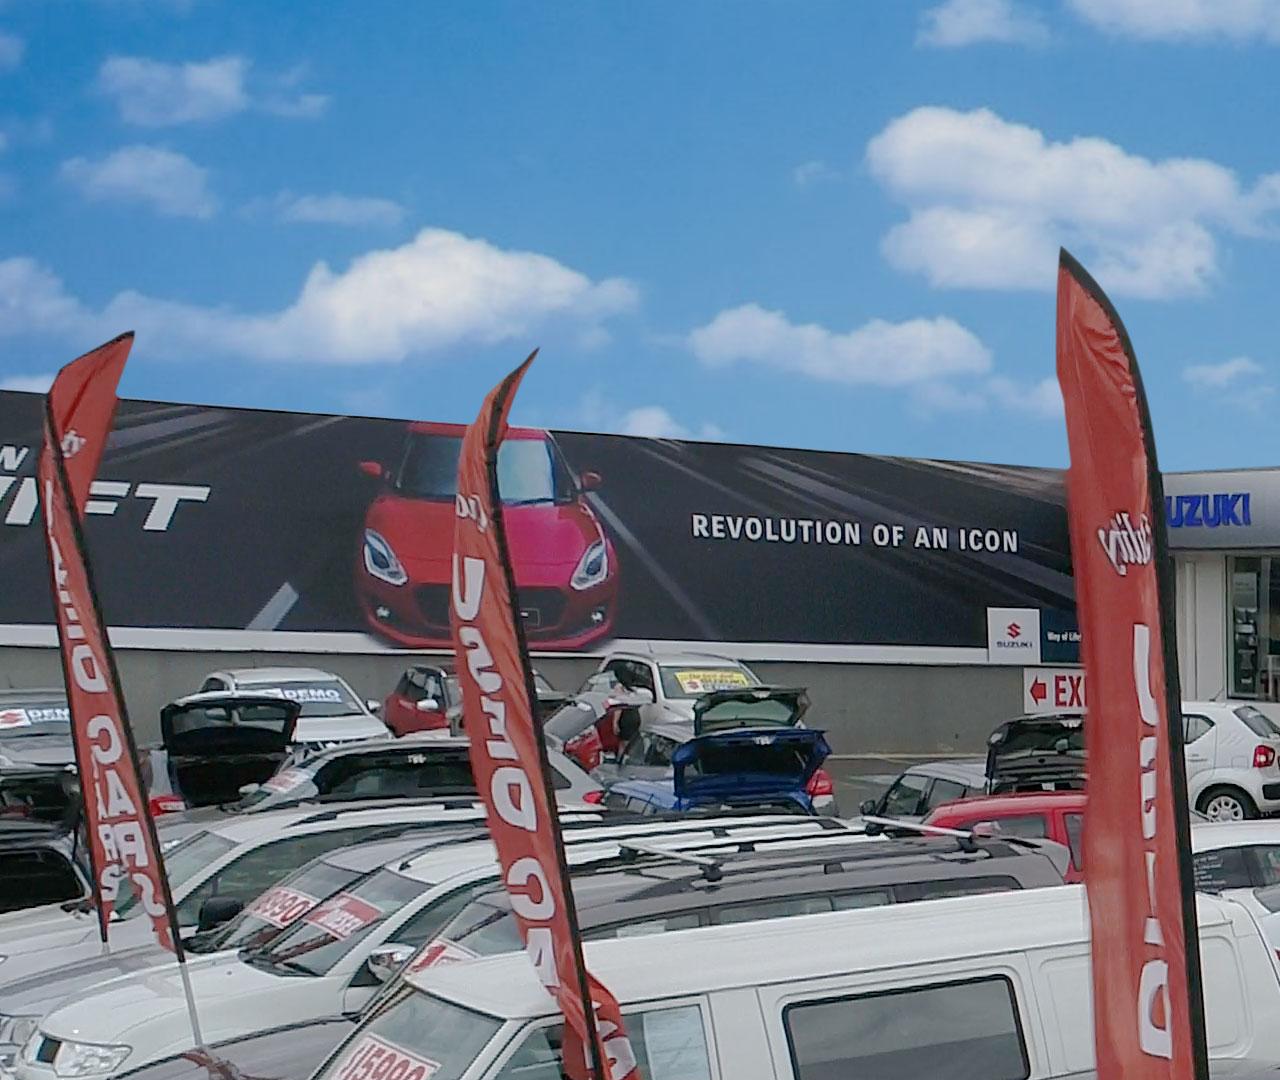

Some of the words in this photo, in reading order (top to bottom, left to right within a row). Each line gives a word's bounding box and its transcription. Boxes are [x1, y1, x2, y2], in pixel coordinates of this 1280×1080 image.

[1165, 493, 1251, 528] UZUKI
[692, 514, 861, 545] REVOLUTION
[873, 524, 904, 547] OF
[914, 527, 948, 549] AN
[960, 529, 1018, 552] ICON
[1055, 675, 1088, 707] EXI
[28, 708, 69, 720] DEM
